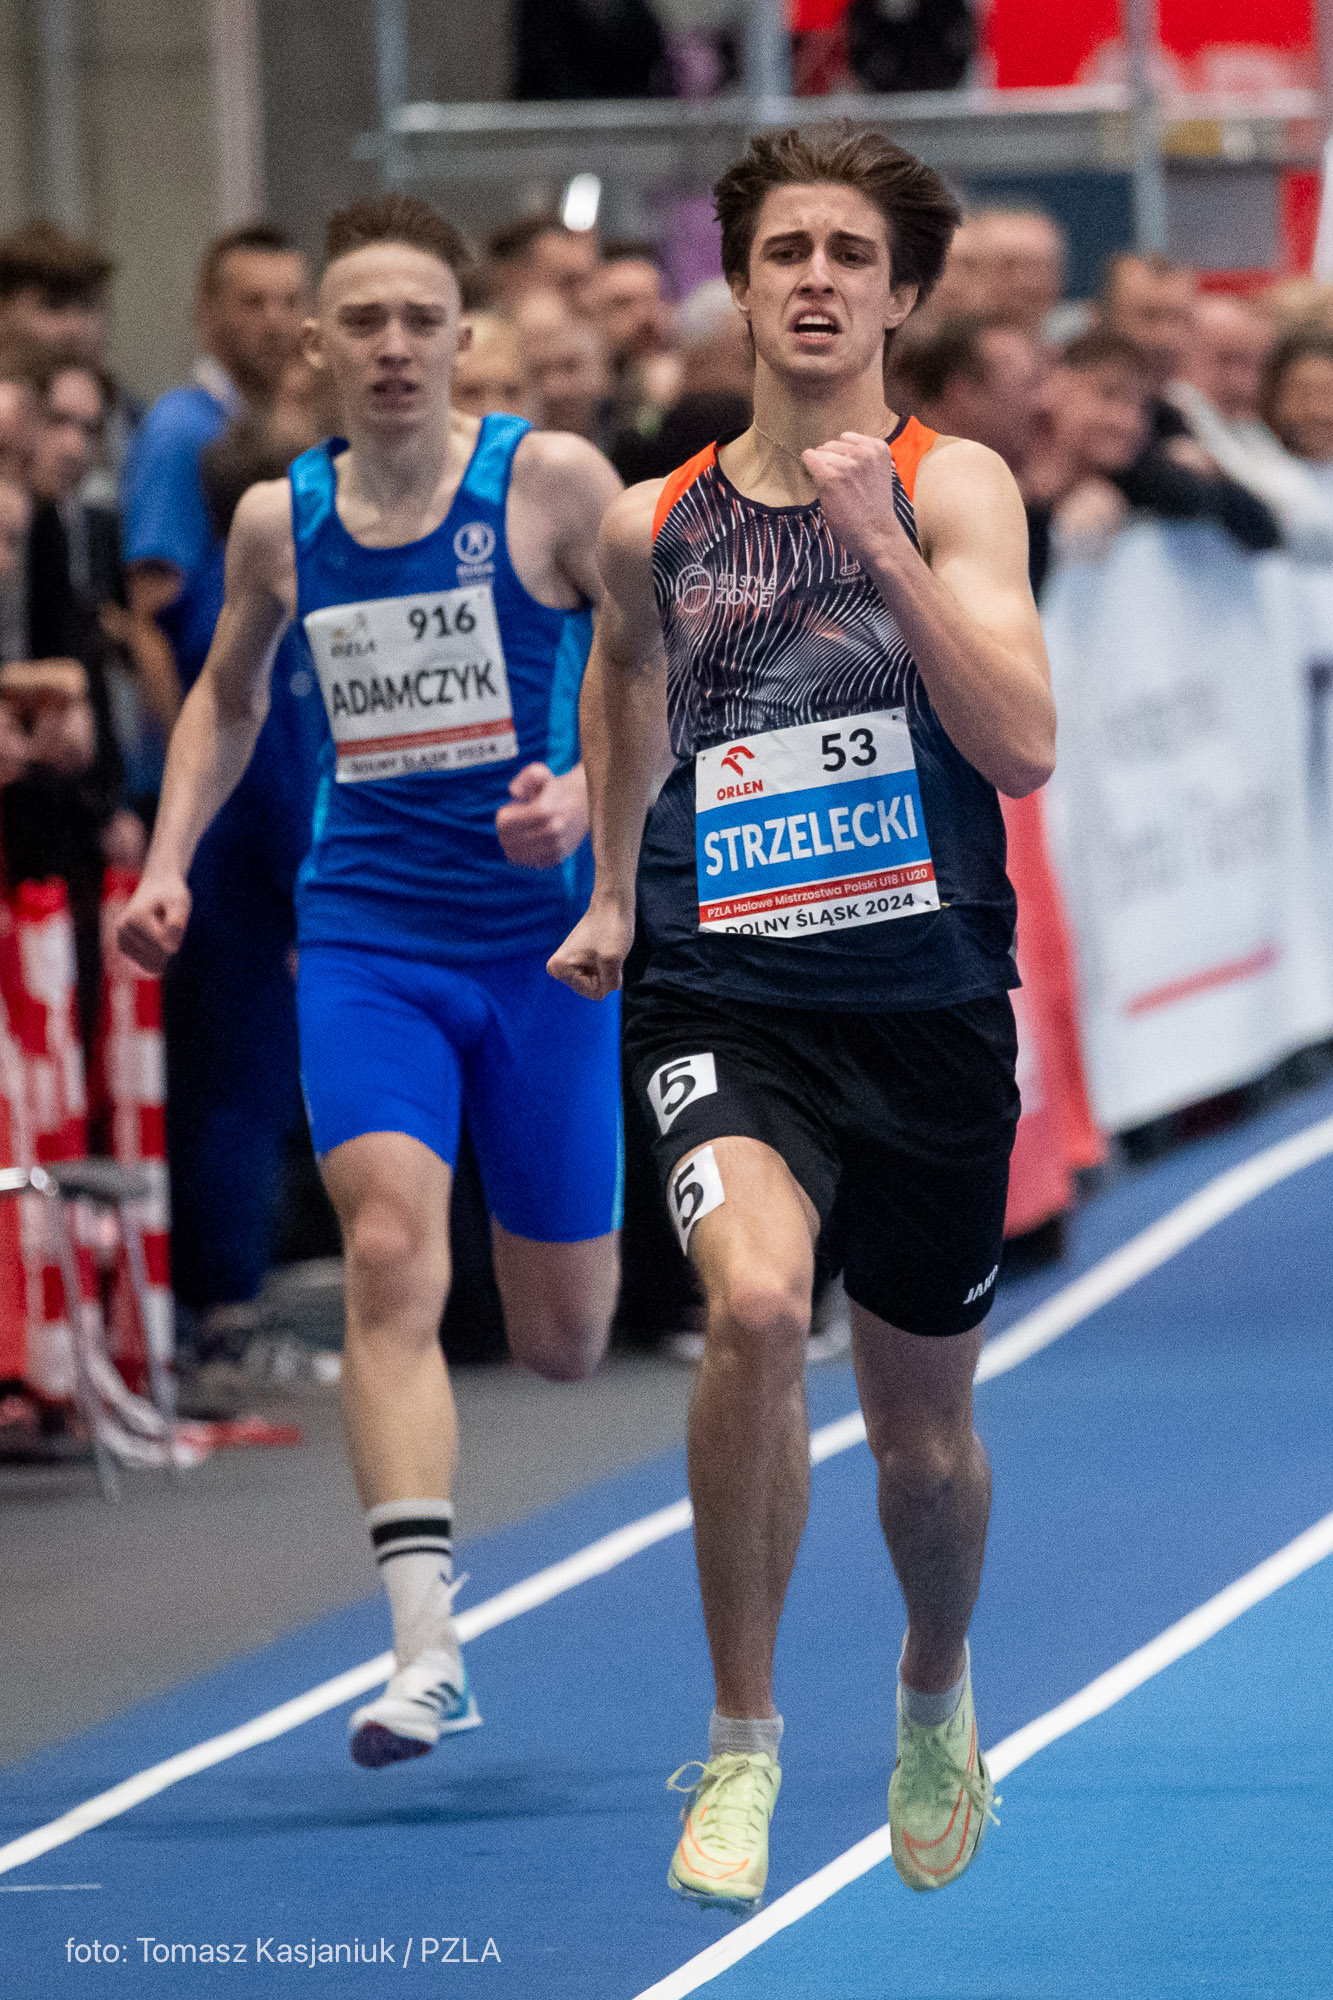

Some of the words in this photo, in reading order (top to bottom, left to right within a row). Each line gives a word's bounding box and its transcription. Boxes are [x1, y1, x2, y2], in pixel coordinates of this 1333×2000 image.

[715, 587, 774, 608] ZONE
[408, 602, 477, 642] 916
[331, 661, 498, 717] ADAMCZYK
[820, 728, 877, 772] 53
[717, 779, 764, 801] ORLEN
[704, 794, 919, 877] STRZELECKI
[707, 906, 732, 919] PZLA
[733, 899, 774, 914] Halowe
[775, 887, 843, 906] Mistrzostwa
[844, 878, 878, 893] Polski
[880, 873, 900, 887] U18
[901, 872, 905, 882] i
[907, 868, 928, 881] U20
[795, 903, 861, 928] ŚLĄSK
[864, 892, 915, 916] 2024
[659, 1060, 696, 1116] 5
[674, 1162, 704, 1230] 5
